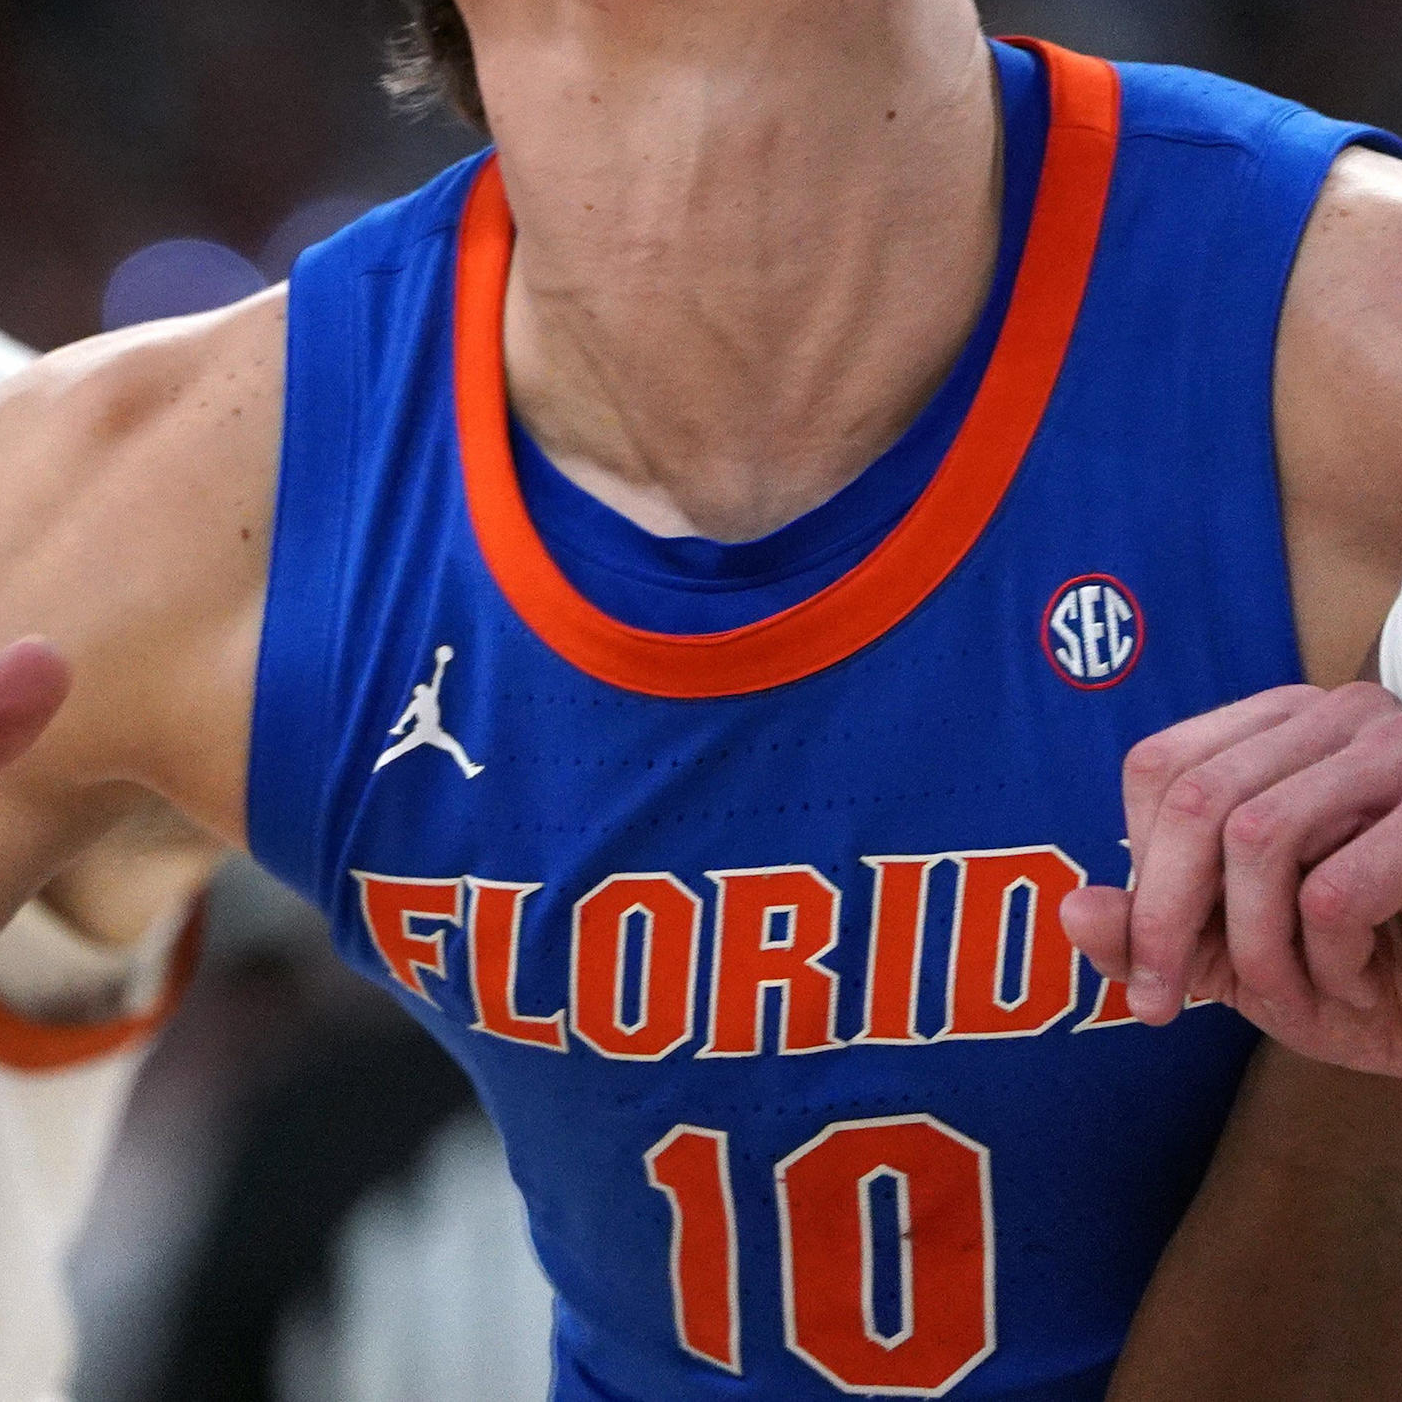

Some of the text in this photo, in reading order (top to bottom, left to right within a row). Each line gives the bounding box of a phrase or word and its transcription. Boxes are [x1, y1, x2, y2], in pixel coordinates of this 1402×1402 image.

[1050, 584, 1134, 678] SEC
[349, 839, 1220, 1062] FLORID
[645, 1112, 993, 1399] 10
